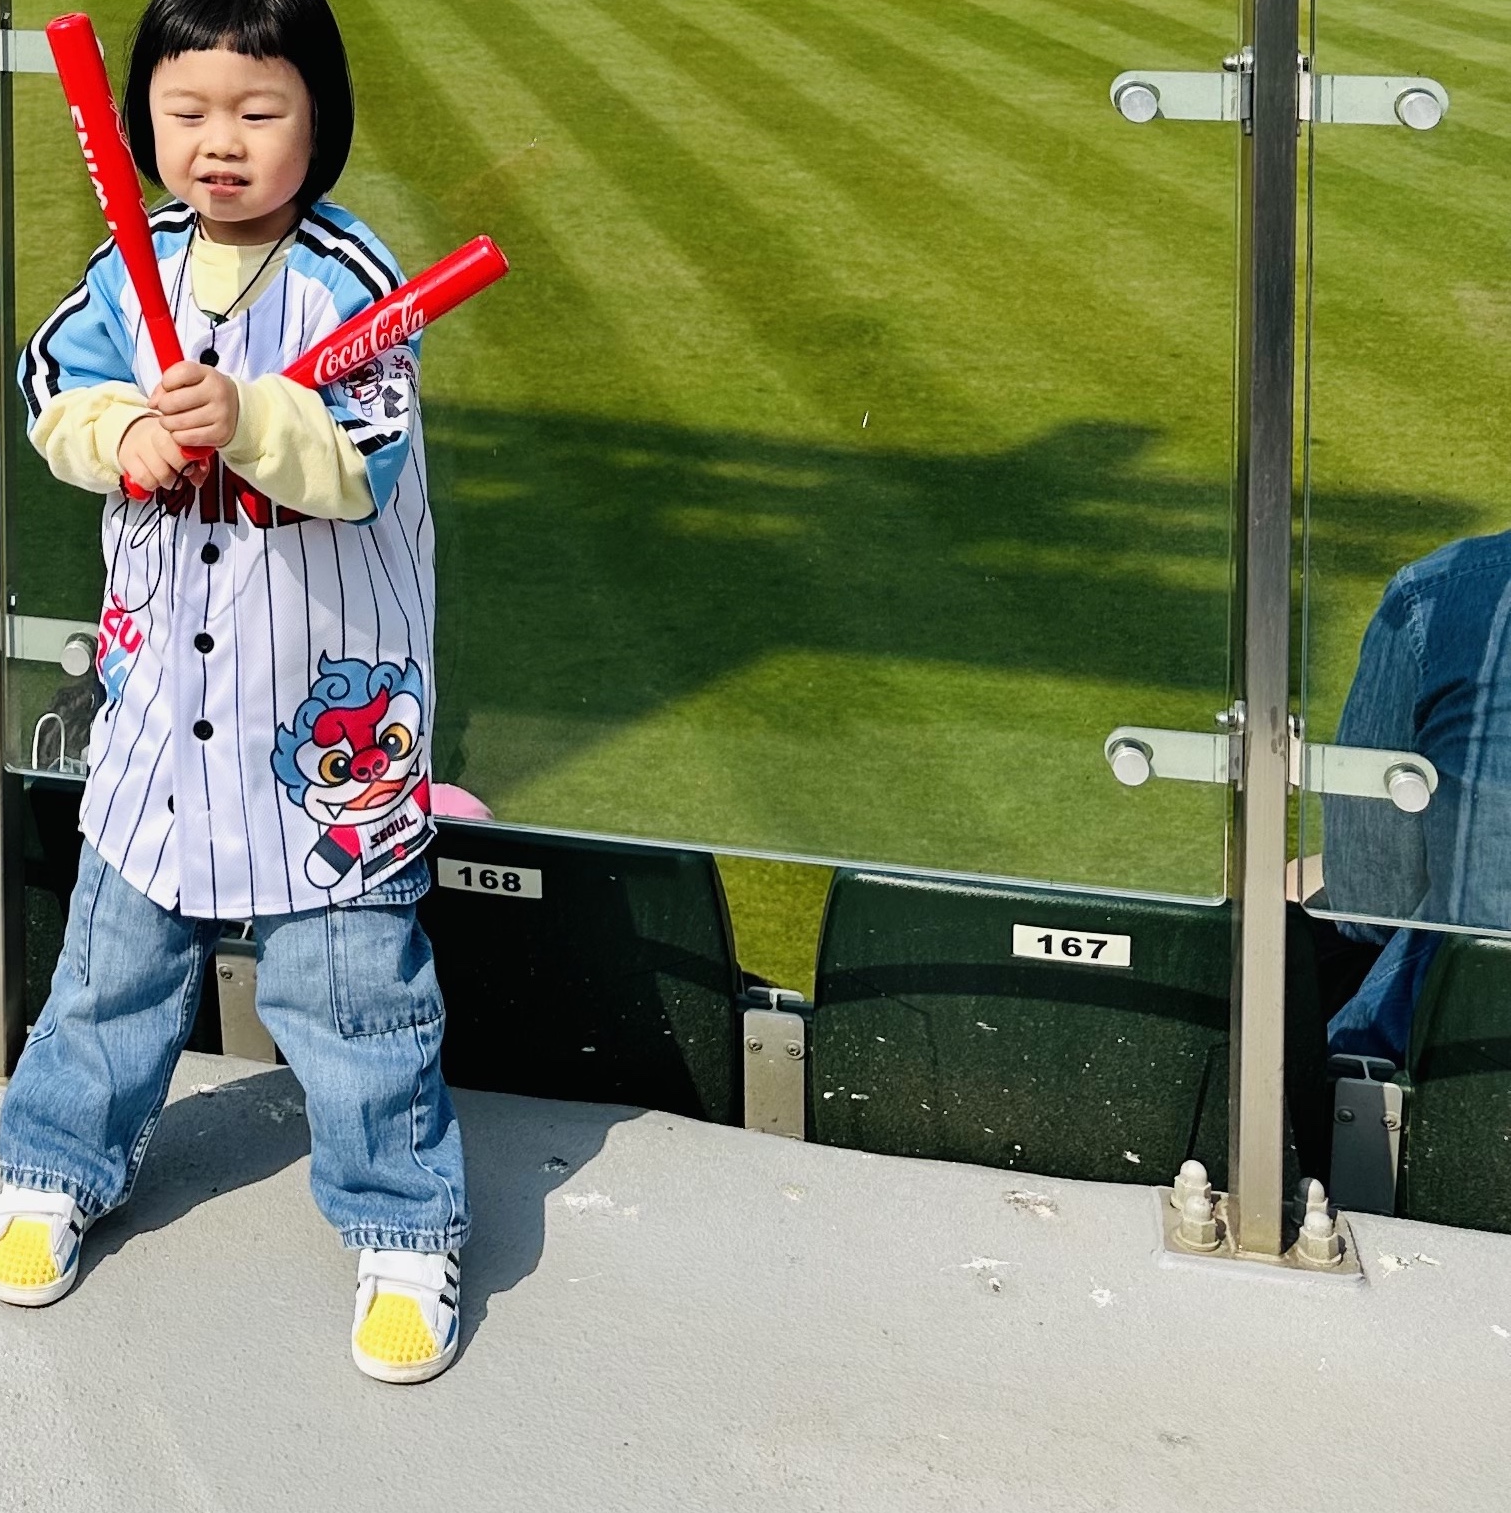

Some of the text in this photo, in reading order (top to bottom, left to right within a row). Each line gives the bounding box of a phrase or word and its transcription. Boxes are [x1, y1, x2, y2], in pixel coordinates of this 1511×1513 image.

[314, 287, 428, 385] Coca-Cola
[369, 814, 418, 850] SEOUL
[457, 866, 521, 892] 168
[1035, 933, 1109, 961] 167
